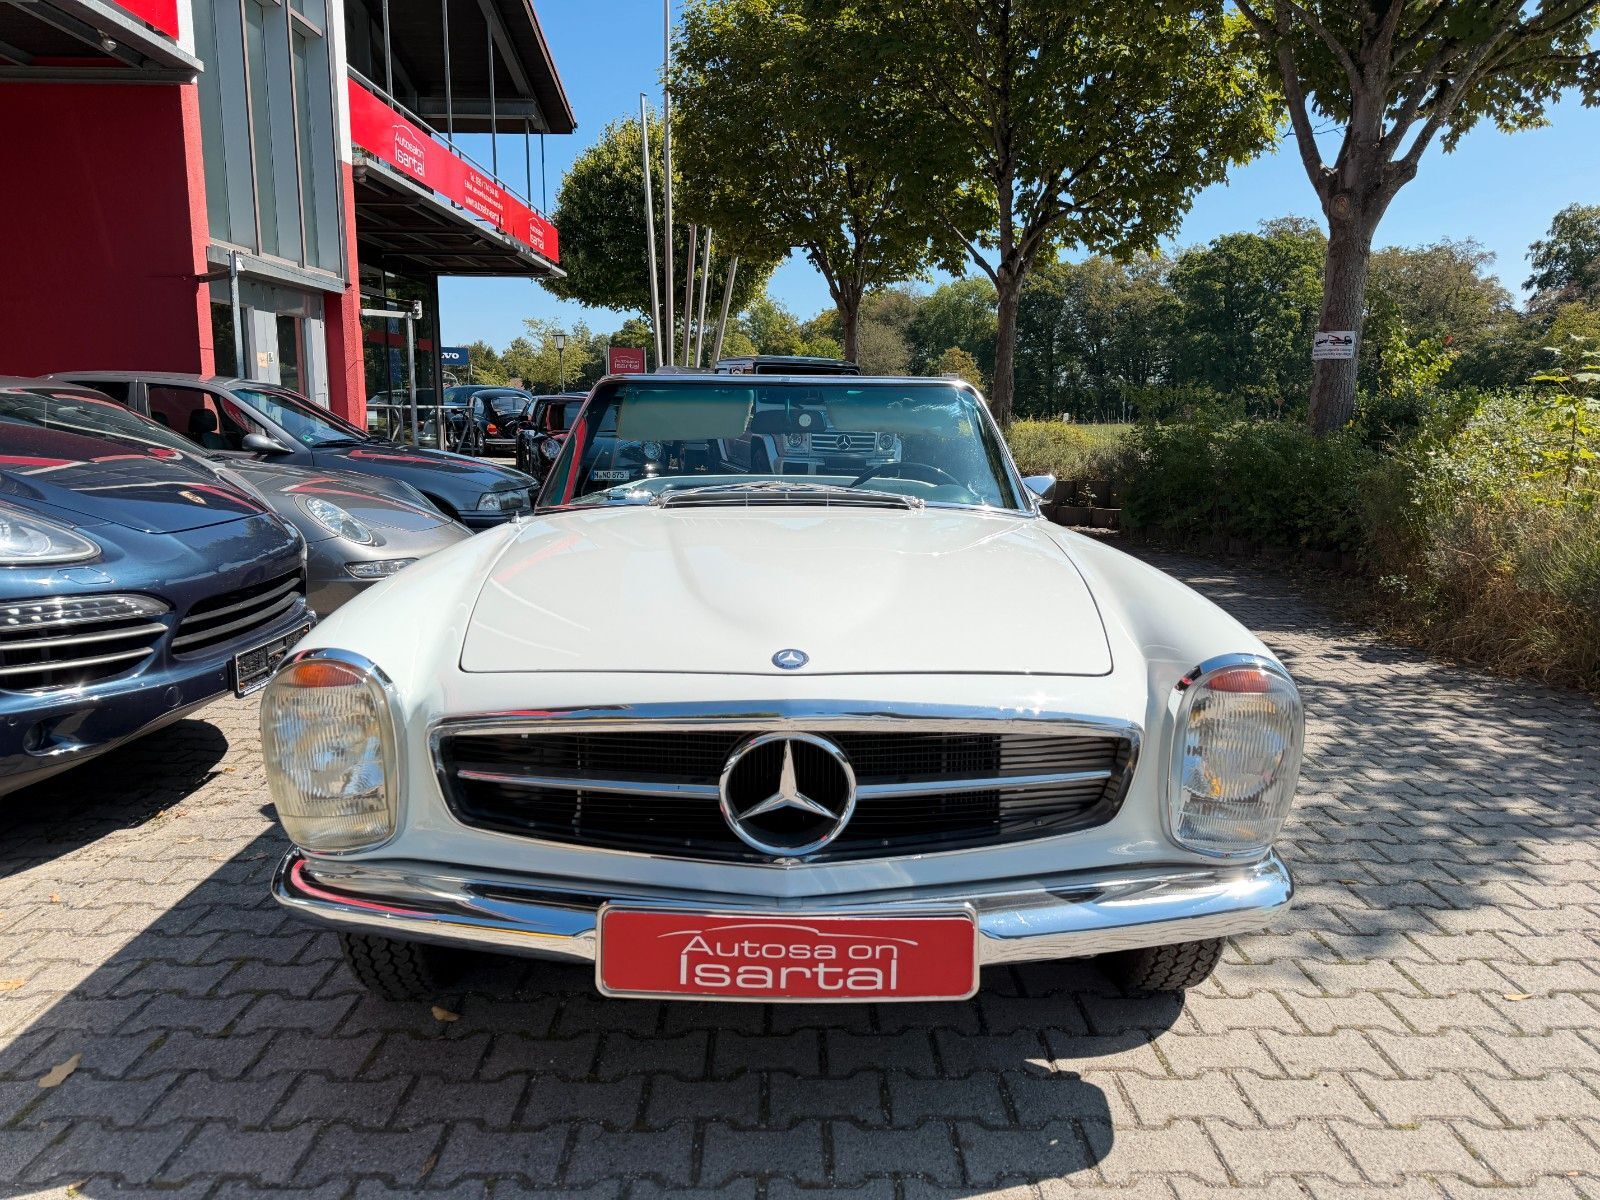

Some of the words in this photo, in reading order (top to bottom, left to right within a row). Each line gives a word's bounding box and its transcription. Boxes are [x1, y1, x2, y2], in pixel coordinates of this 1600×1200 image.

[395, 132, 425, 160] Autosalon
[395, 141, 426, 177] Isartal
[680, 953, 898, 991] Isartal
